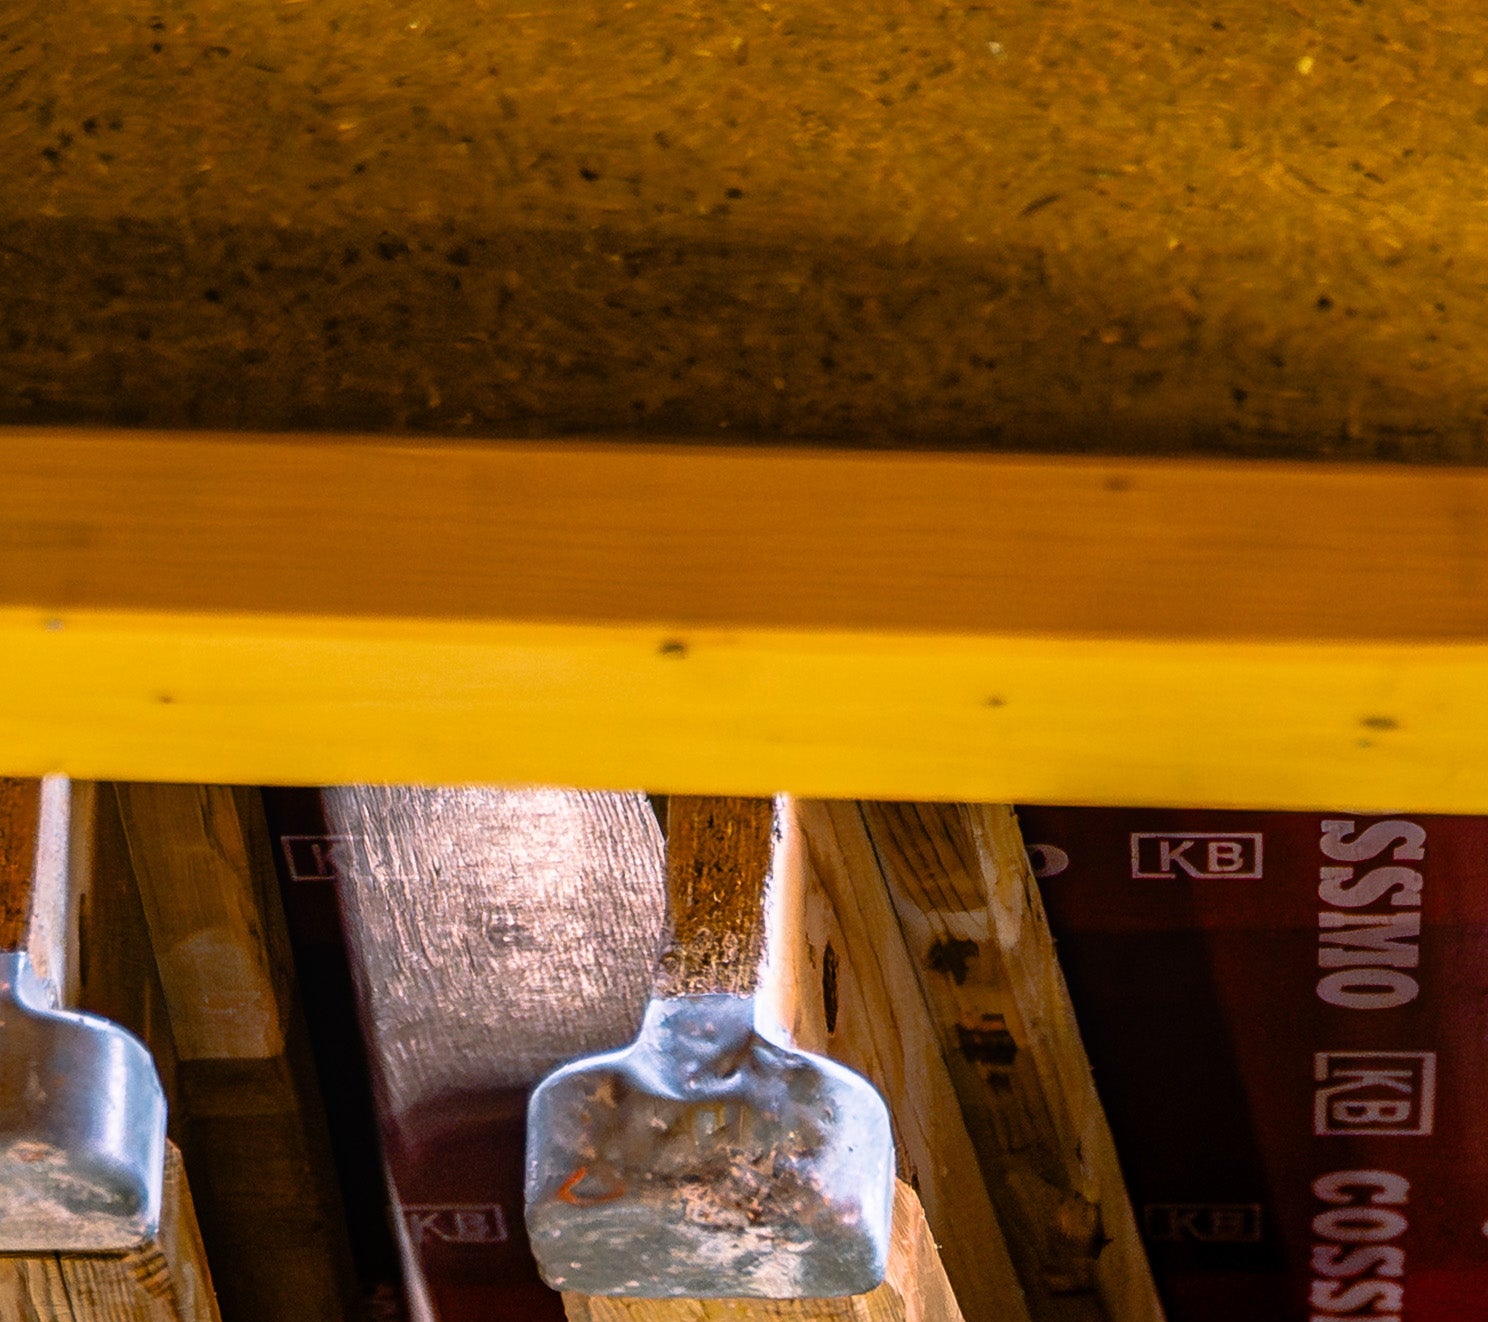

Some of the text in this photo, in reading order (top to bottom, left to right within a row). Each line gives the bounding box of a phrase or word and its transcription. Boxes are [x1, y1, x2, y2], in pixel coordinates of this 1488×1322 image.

[1156, 837, 1247, 878] KB
[1316, 818, 1427, 1010] SSMO
[1325, 1064, 1416, 1127] KB
